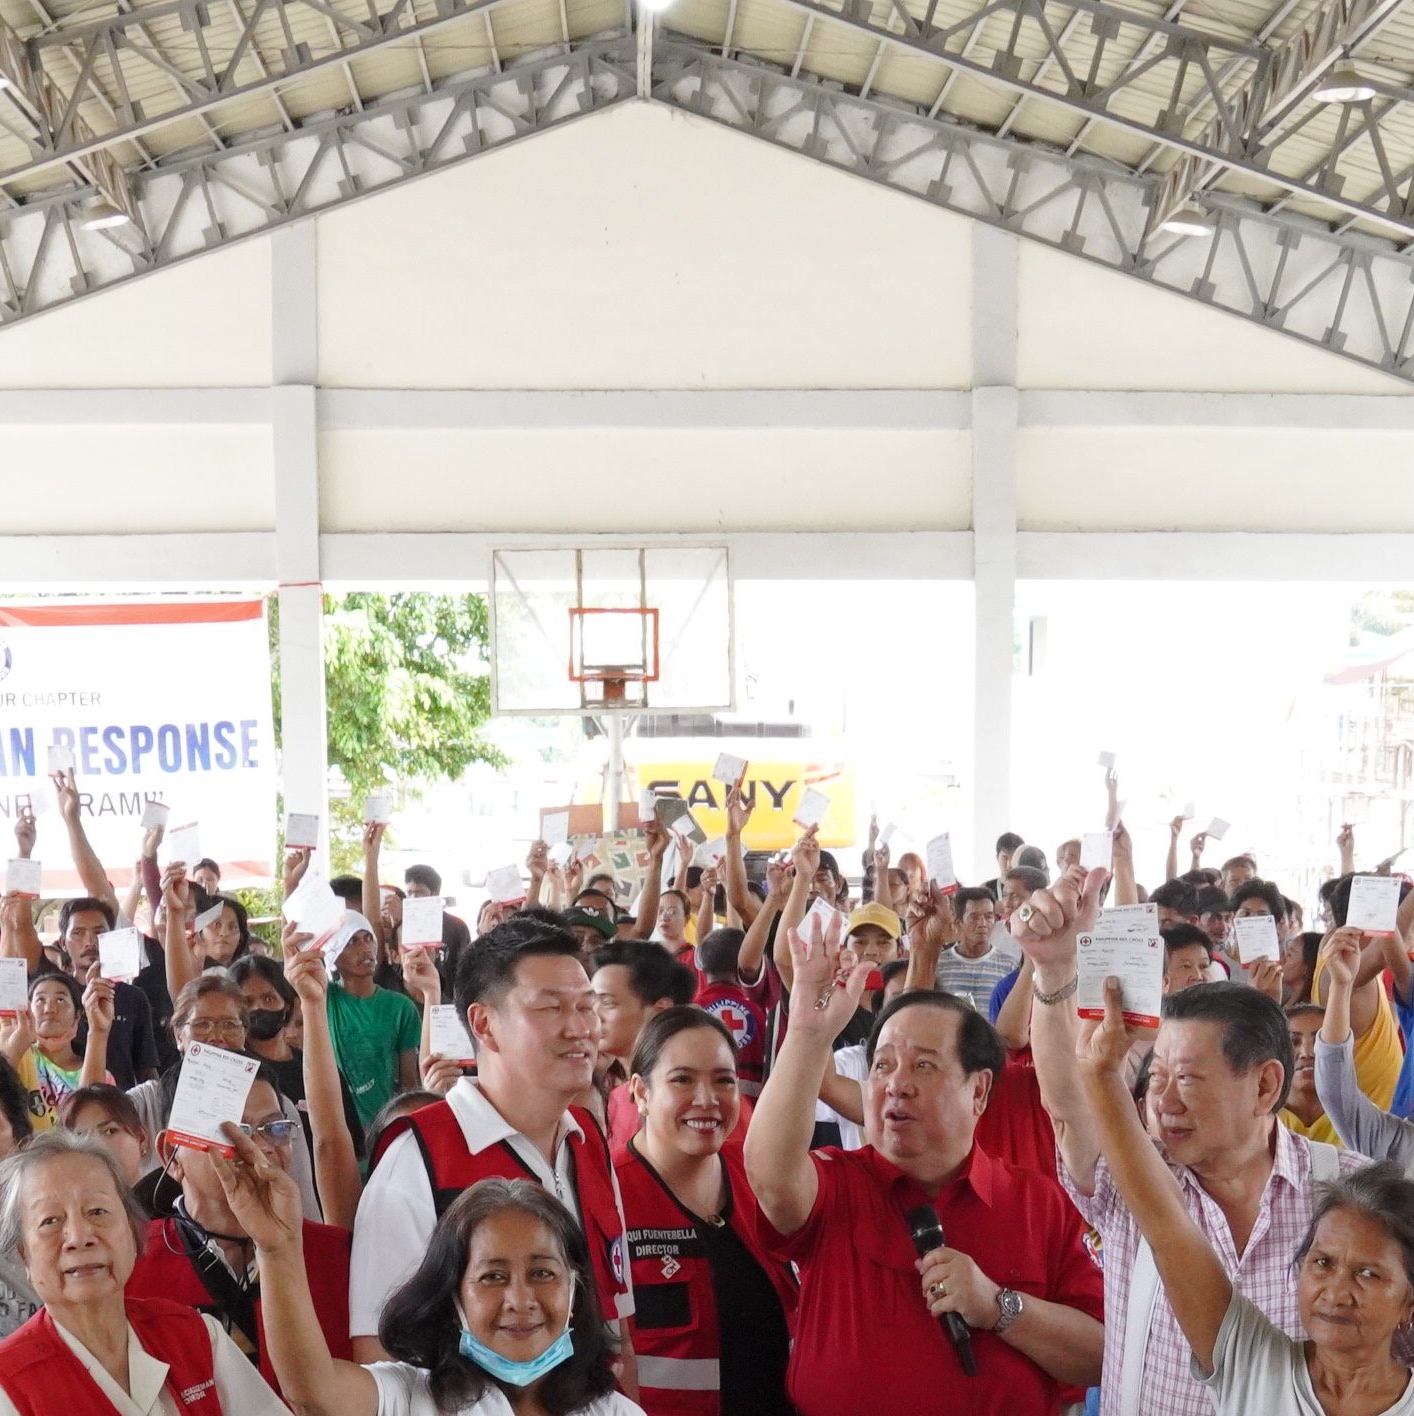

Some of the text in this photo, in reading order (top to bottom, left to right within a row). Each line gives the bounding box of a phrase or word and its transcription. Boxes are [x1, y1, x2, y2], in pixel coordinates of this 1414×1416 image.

[22, 692, 102, 707] CHAPTER
[52, 719, 259, 776] RESPONSE
[647, 780, 797, 809] SANY
[706, 999, 750, 1015] HILIPPINE
[737, 1033, 752, 1049] OSS
[627, 1228, 697, 1243] QUI FUENTEBELLA
[635, 1244, 679, 1257] DIRECTOR
